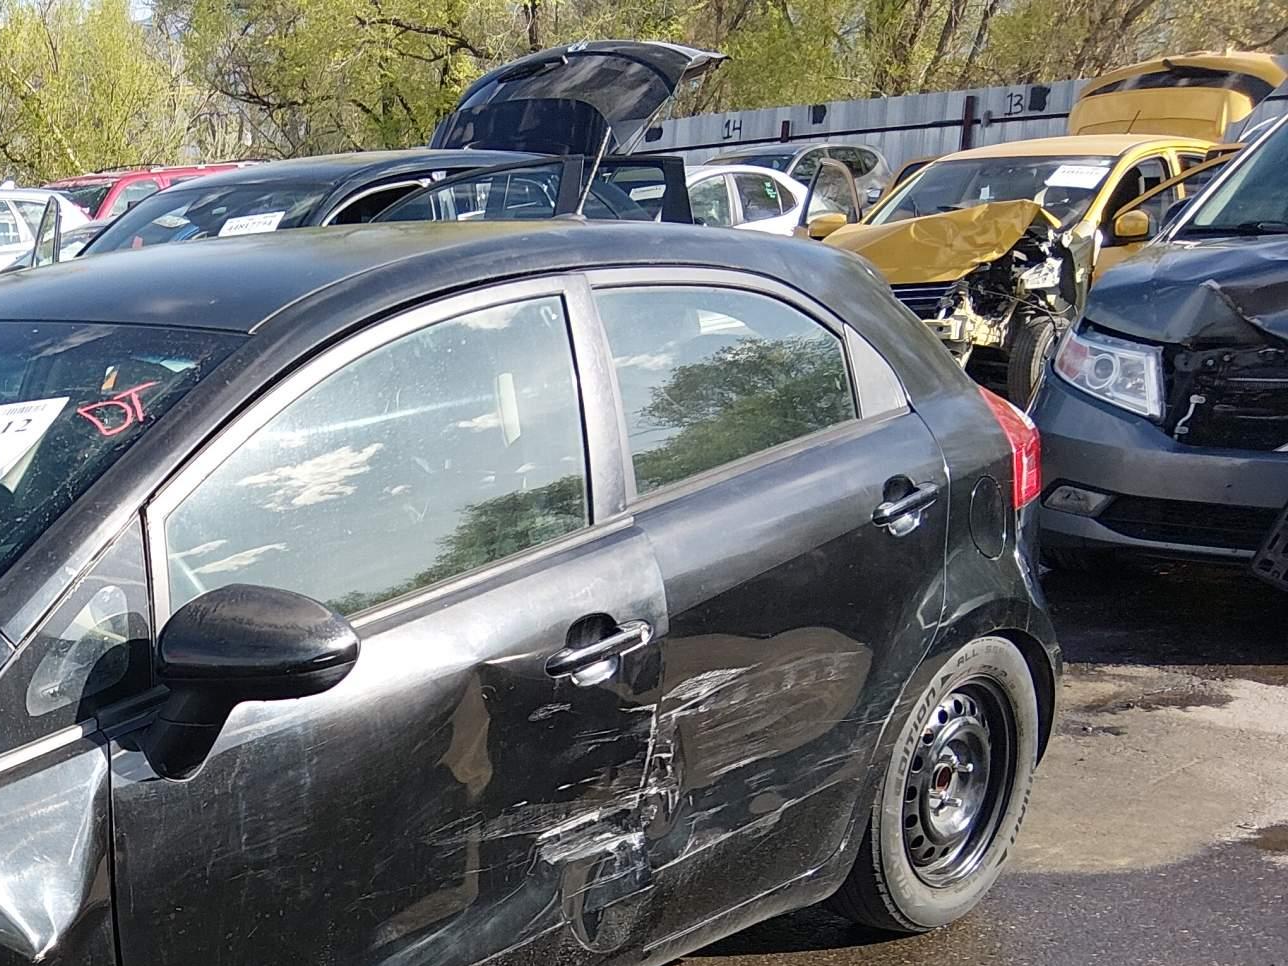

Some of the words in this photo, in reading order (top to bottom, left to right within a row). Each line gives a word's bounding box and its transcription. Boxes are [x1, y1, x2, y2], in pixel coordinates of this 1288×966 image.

[1003, 92, 1024, 116] 13
[721, 119, 742, 140] 14
[77, 381, 161, 436] DT
